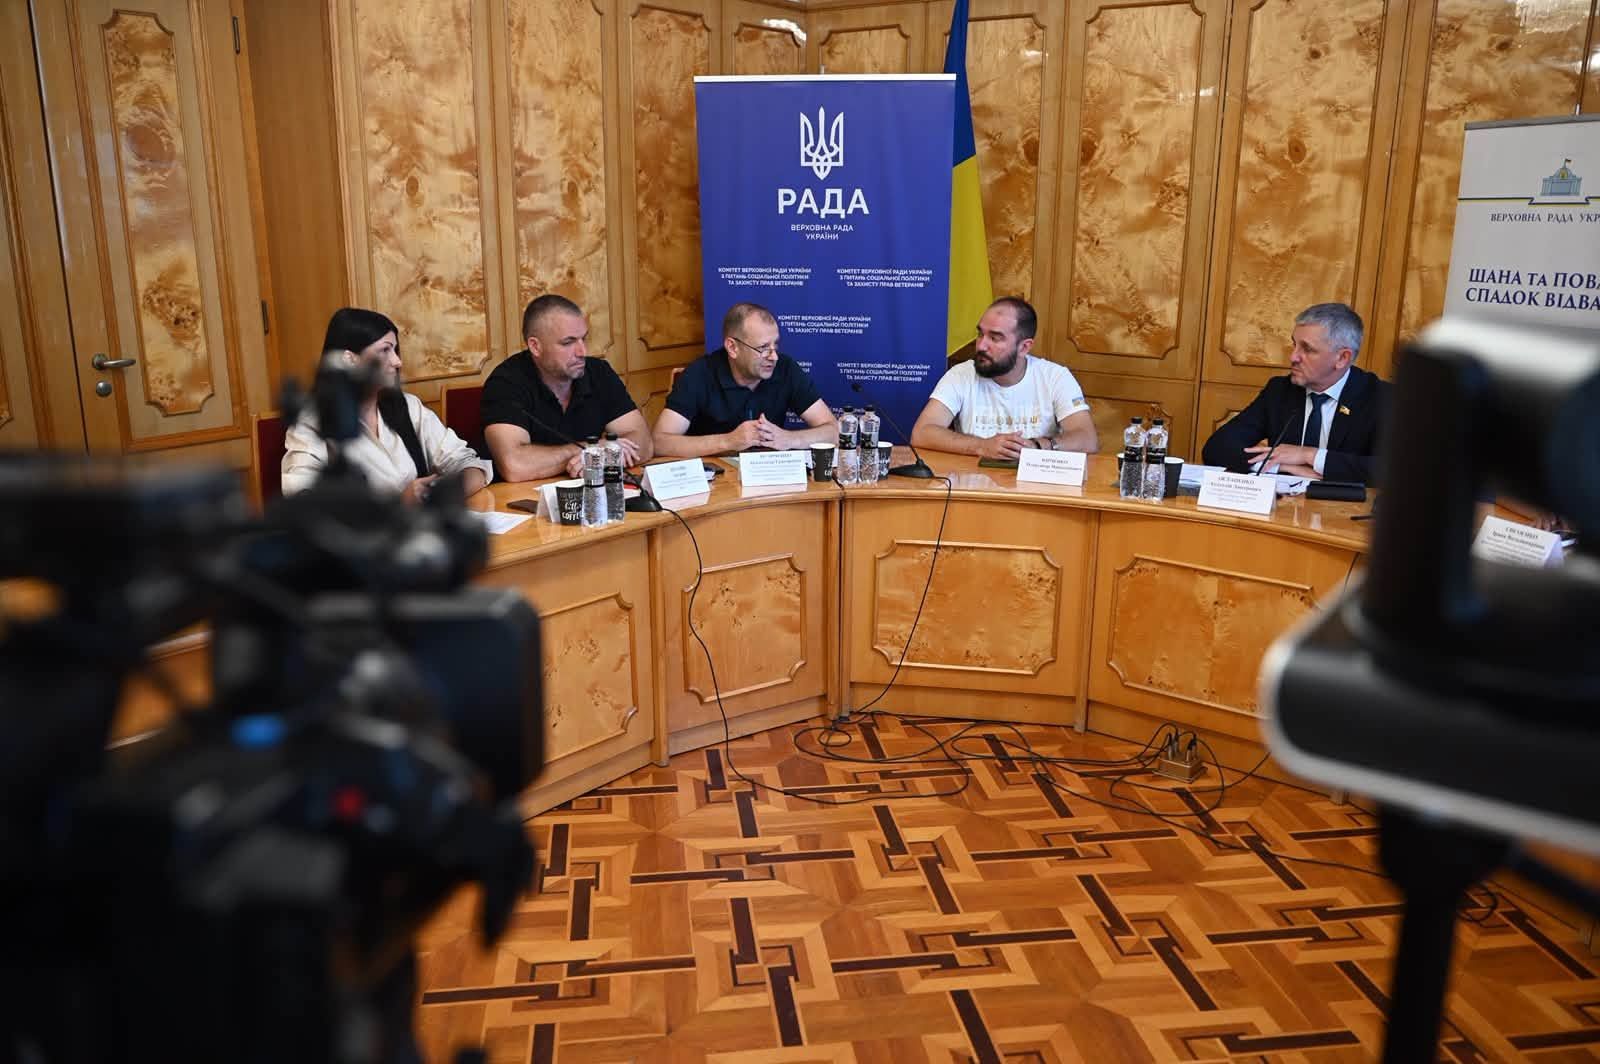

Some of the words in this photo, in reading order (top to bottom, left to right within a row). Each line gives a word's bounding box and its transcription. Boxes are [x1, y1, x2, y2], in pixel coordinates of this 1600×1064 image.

[778, 188, 870, 219] РАДА
[1490, 212, 1542, 222] ВЕРХОВНА
[1547, 213, 1574, 223] РАДА
[833, 224, 854, 232] РАДА
[805, 232, 840, 240] УКРАЇНИ
[1469, 268, 1521, 284] ШАНА
[1528, 272, 1547, 286] ТА
[1466, 287, 1540, 306] СПАДОК
